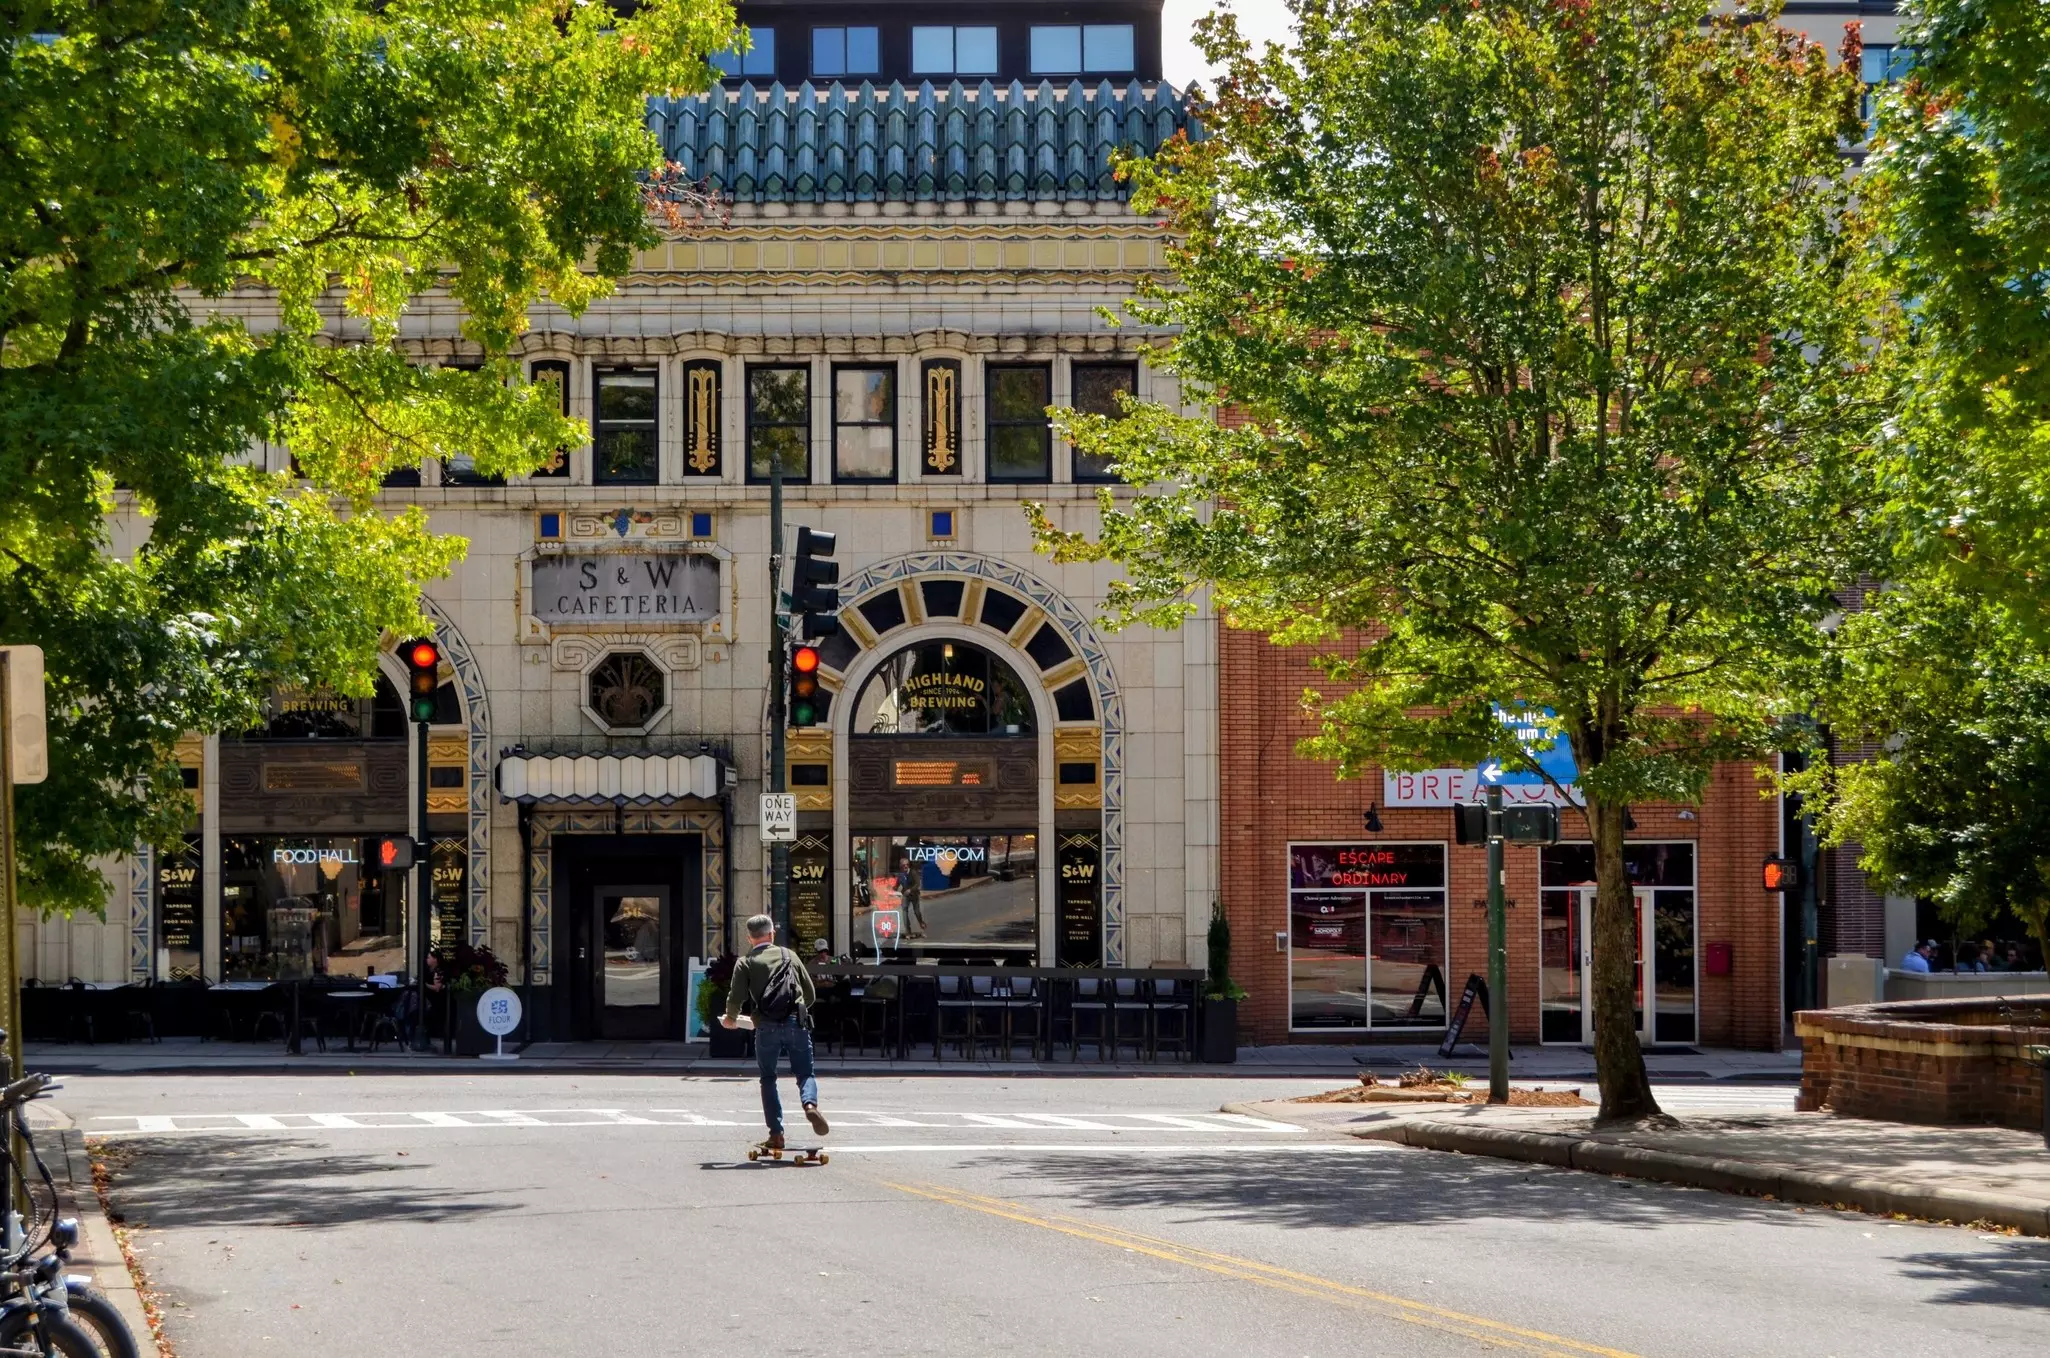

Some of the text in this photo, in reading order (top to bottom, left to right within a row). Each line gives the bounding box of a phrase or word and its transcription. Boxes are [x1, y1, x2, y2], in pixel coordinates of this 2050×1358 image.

[579, 561, 675, 591] S & W
[557, 596, 696, 614] CAFETERIA
[904, 672, 985, 692] HIGHLAND
[923, 687, 960, 695] SINCE 1994
[282, 700, 348, 711] BREWING
[910, 696, 976, 708] BREWING
[765, 798, 791, 809] ONE
[765, 811, 792, 822] WAY
[273, 849, 359, 863] FOOD HALL
[905, 847, 985, 861] TAPROOM
[1339, 852, 1395, 864] ESCAPE
[160, 869, 196, 882] S&W
[433, 868, 463, 881] S&W
[792, 865, 825, 879] S&W
[1062, 865, 1095, 878] S&W
[1331, 873, 1408, 885] ORDINARY
[488, 1016, 511, 1024] FLOUR
